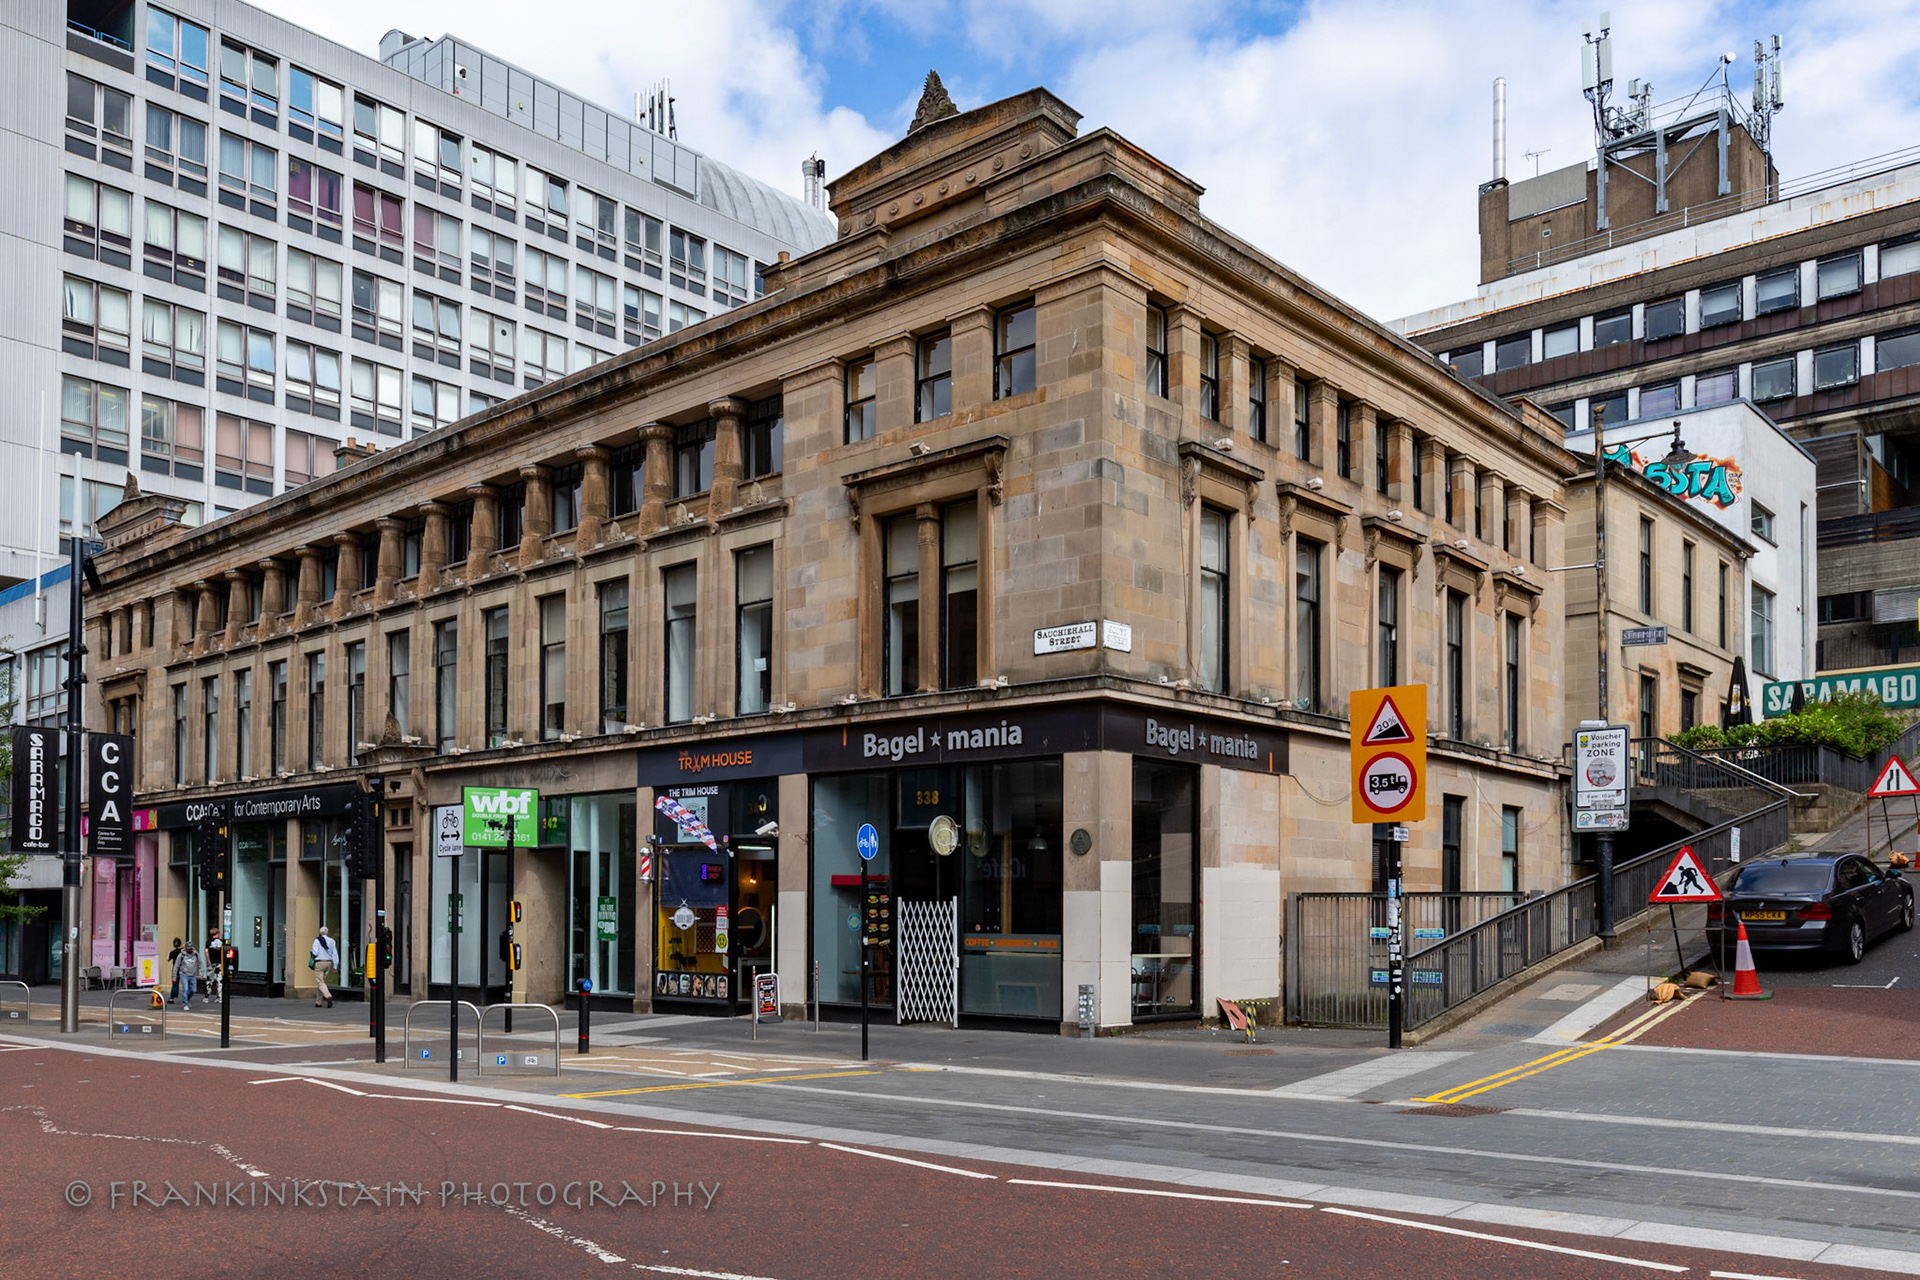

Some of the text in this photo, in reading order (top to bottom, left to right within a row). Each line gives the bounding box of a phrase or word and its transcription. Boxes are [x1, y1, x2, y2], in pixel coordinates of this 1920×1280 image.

[1037, 624, 1094, 640] SAUCHIEHALL
[1049, 636, 1081, 646] STREET
[1376, 715, 1397, 732] 20%
[863, 719, 1023, 762] Bagel mania
[1146, 718, 1258, 760] Bagel mania
[1591, 733, 1622, 741] Voucher
[1591, 741, 1621, 749] parking
[712, 751, 753, 767] HOUSE
[1586, 748, 1615, 757] ZONE
[30, 733, 45, 840] SARAMAGO
[100, 742, 121, 822] CCA
[668, 786, 719, 797] THE TRIM HOUSE
[915, 790, 940, 806] 338
[234, 801, 245, 817] for
[245, 798, 302, 817] Contemporary
[303, 794, 321, 810] Arts
[470, 790, 532, 814] wbf
[542, 816, 558, 830] 342
[471, 832, 492, 841] 0141
[439, 844, 451, 853] Cycle
[964, 938, 990, 947] COFFEE
